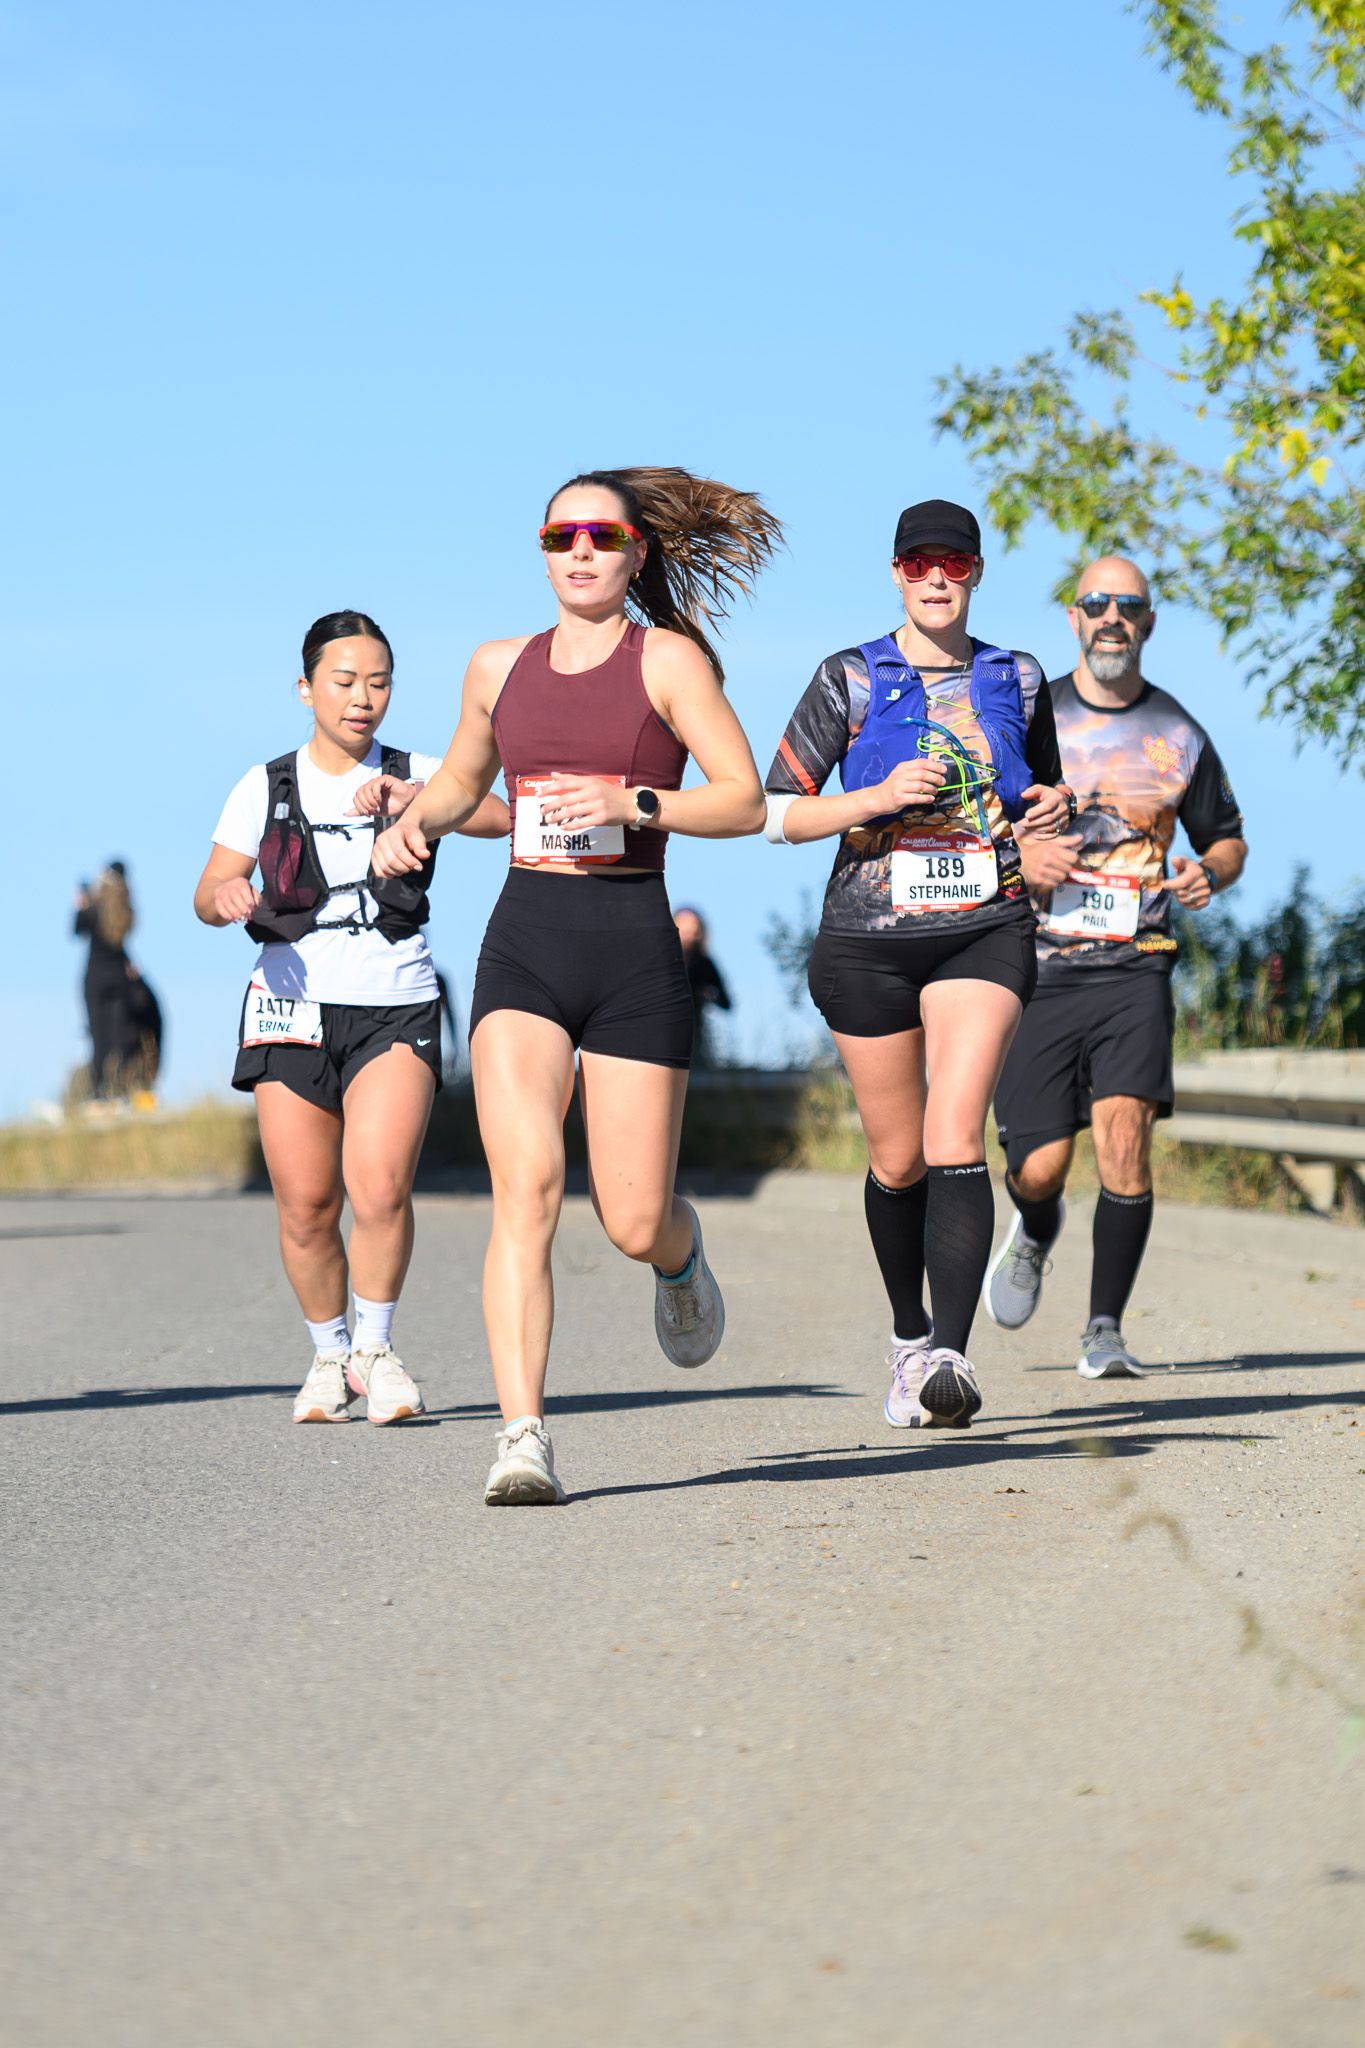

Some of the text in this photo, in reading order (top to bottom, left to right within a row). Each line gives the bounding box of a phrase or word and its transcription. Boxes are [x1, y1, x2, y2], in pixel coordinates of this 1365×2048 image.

[541, 834, 591, 850] MASHA
[925, 857, 965, 878] 189
[909, 884, 982, 899] STEPHANIE
[1081, 891, 1114, 911] 190
[1083, 915, 1109, 929] PAUL
[259, 1020, 293, 1033] ERINE
